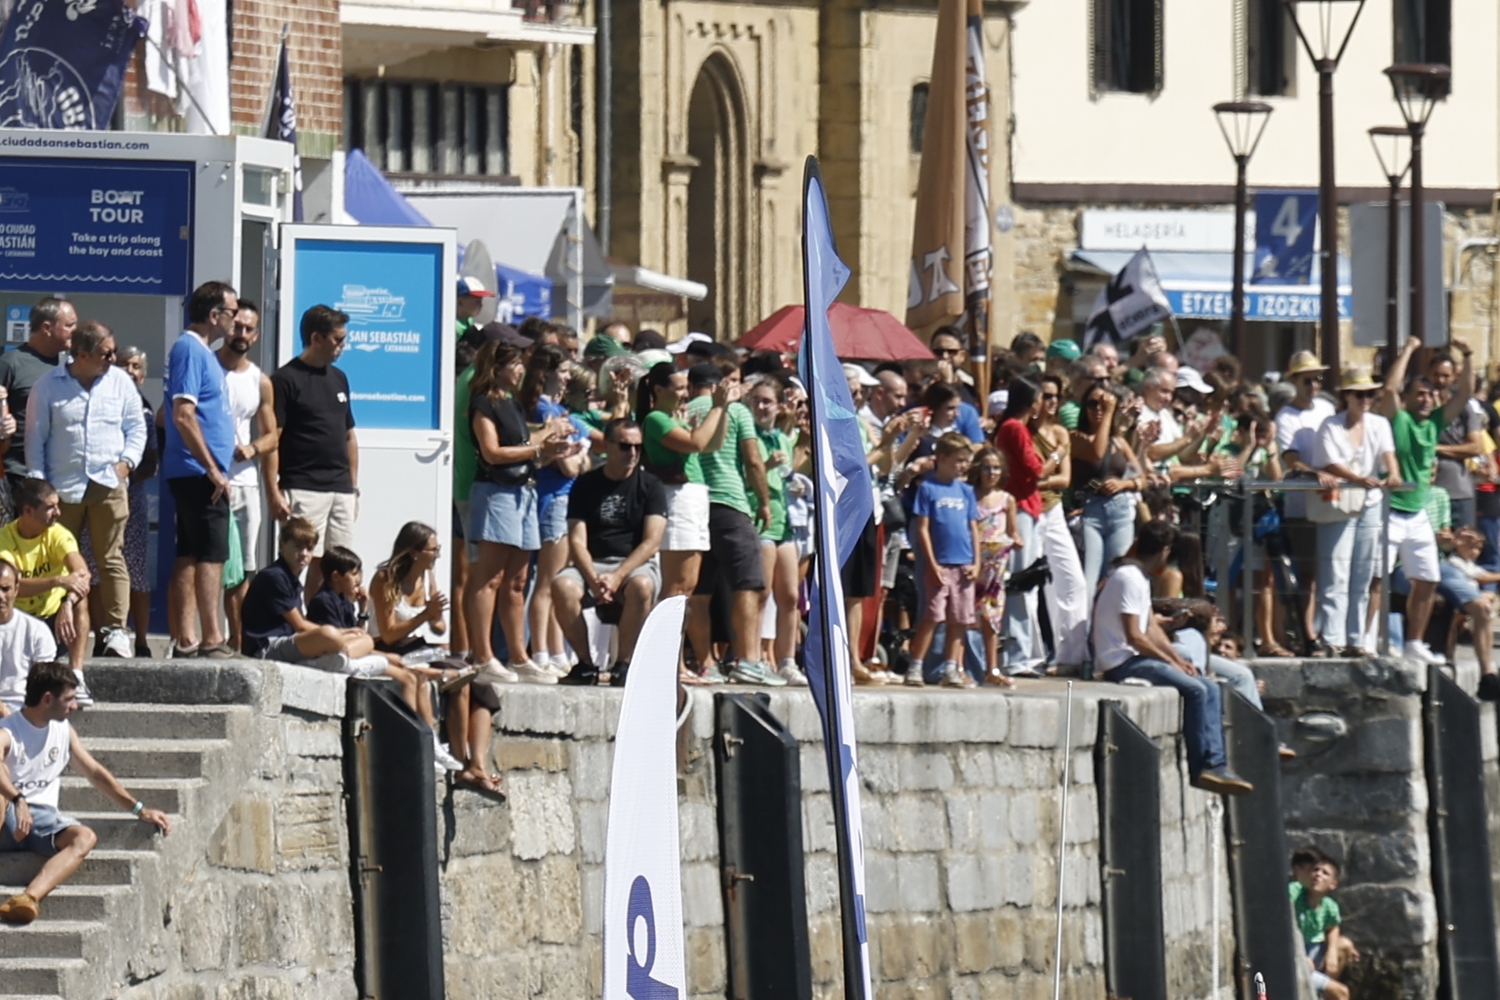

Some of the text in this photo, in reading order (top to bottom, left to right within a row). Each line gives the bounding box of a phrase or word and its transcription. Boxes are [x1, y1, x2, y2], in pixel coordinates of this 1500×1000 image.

[91, 190, 144, 205] BOAT
[90, 208, 144, 223] TOUR
[1271, 196, 1302, 247] 4
[72, 232, 161, 247] Take a trip along
[69, 245, 163, 257] the bay and coast
[349, 330, 420, 344] SAN SEBASTIÁN
